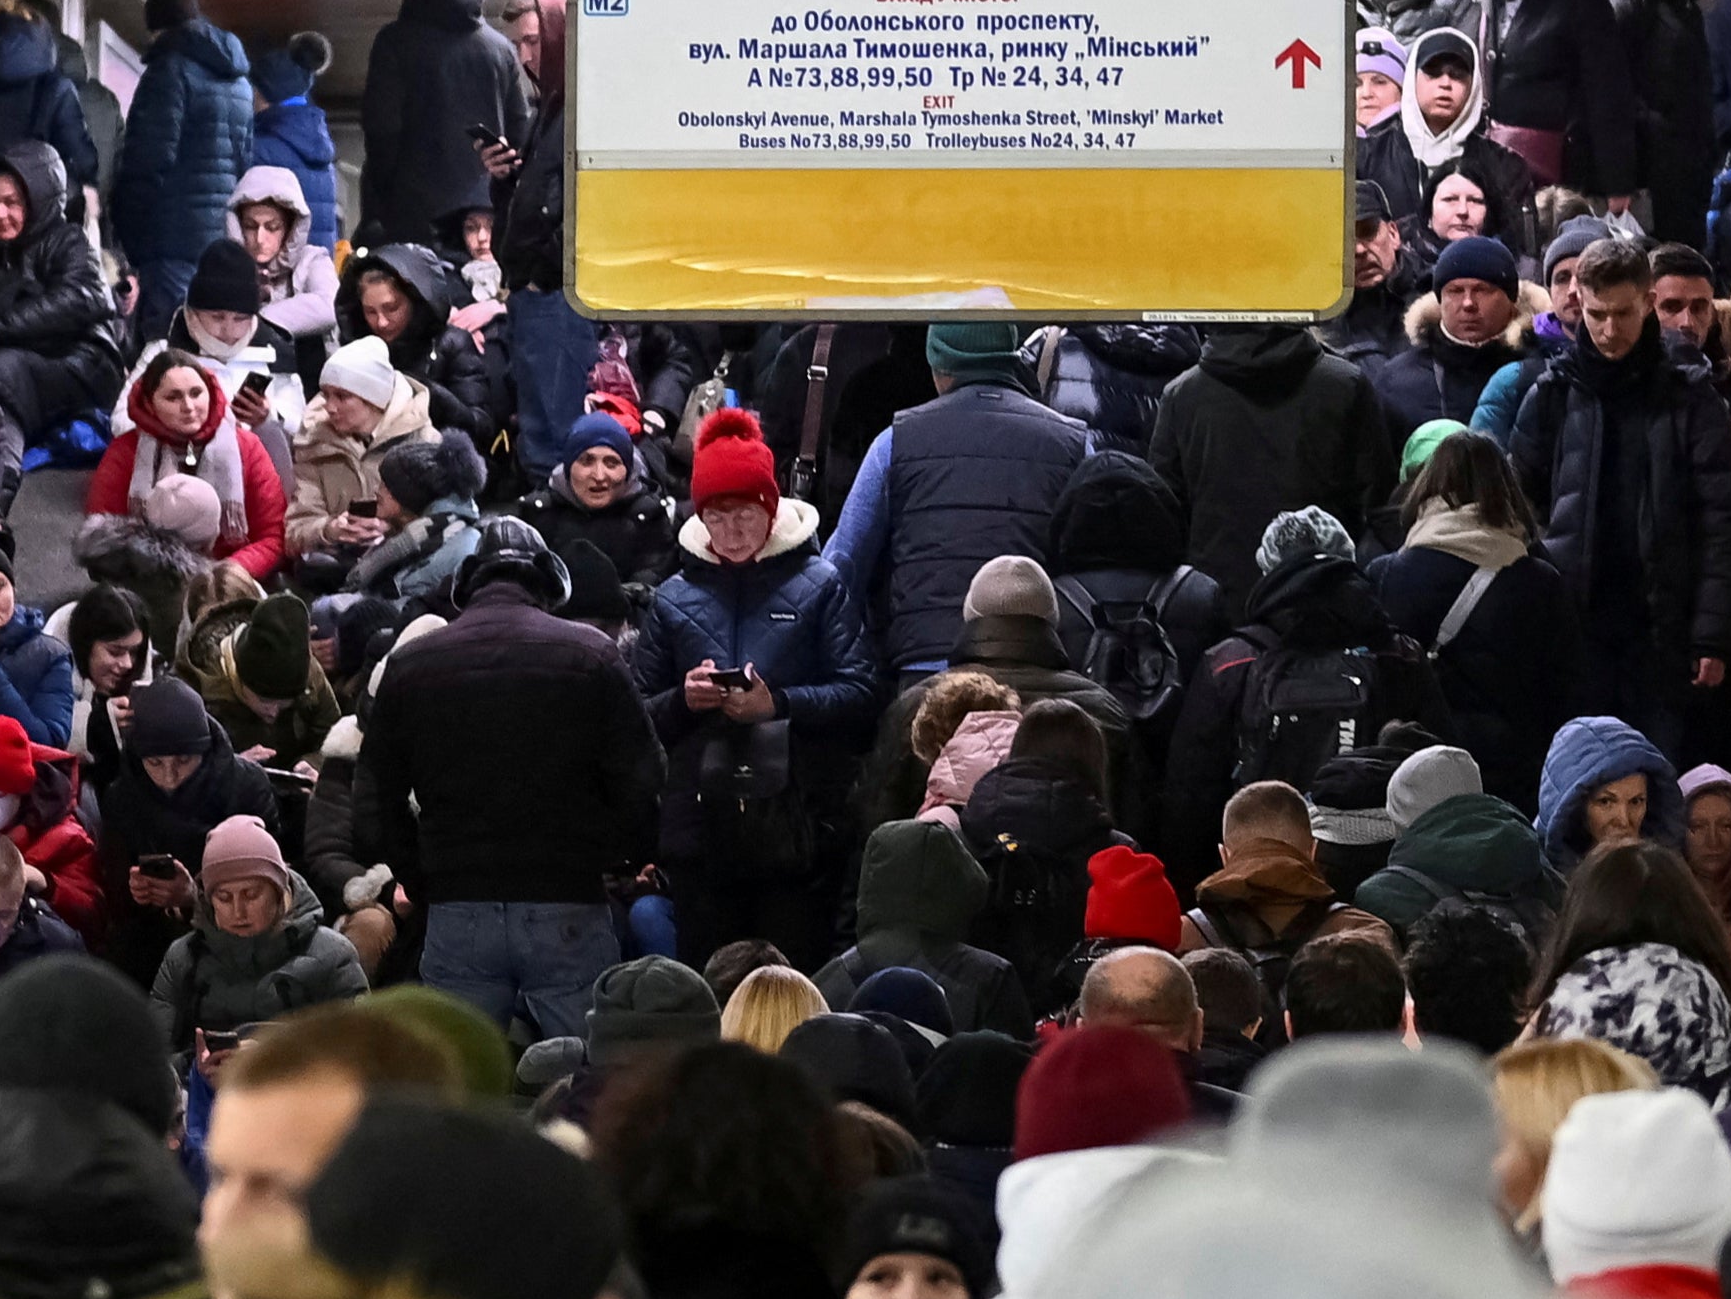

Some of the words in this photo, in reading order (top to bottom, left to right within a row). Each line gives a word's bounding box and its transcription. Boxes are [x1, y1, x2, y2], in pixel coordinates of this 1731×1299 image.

[771, 15, 798, 35] до
[804, 9, 965, 32] Оболонського
[976, 14, 1100, 36] проспекту,
[689, 43, 731, 65] вул.
[738, 38, 847, 64] Маршала
[852, 37, 994, 62] Тимошенка,
[1001, 41, 1069, 63] ринку
[948, 66, 975, 92] Тр
[981, 66, 1007, 87] №
[1012, 65, 1049, 91] 24,
[1055, 66, 1090, 91] 34,
[1096, 66, 1124, 87] 47
[923, 95, 955, 109] EXIT
[770, 111, 835, 129] Avenue,
[839, 110, 917, 127] Marshala
[920, 110, 1021, 130] Tymoshenka
[1025, 109, 1081, 128] Street,
[1164, 108, 1224, 125] Market
[739, 133, 786, 149] Buses
[925, 132, 1027, 152] Trolleybuses
[1031, 132, 1079, 151] No24,
[1083, 132, 1110, 151] 34,
[1114, 132, 1136, 148] 47
